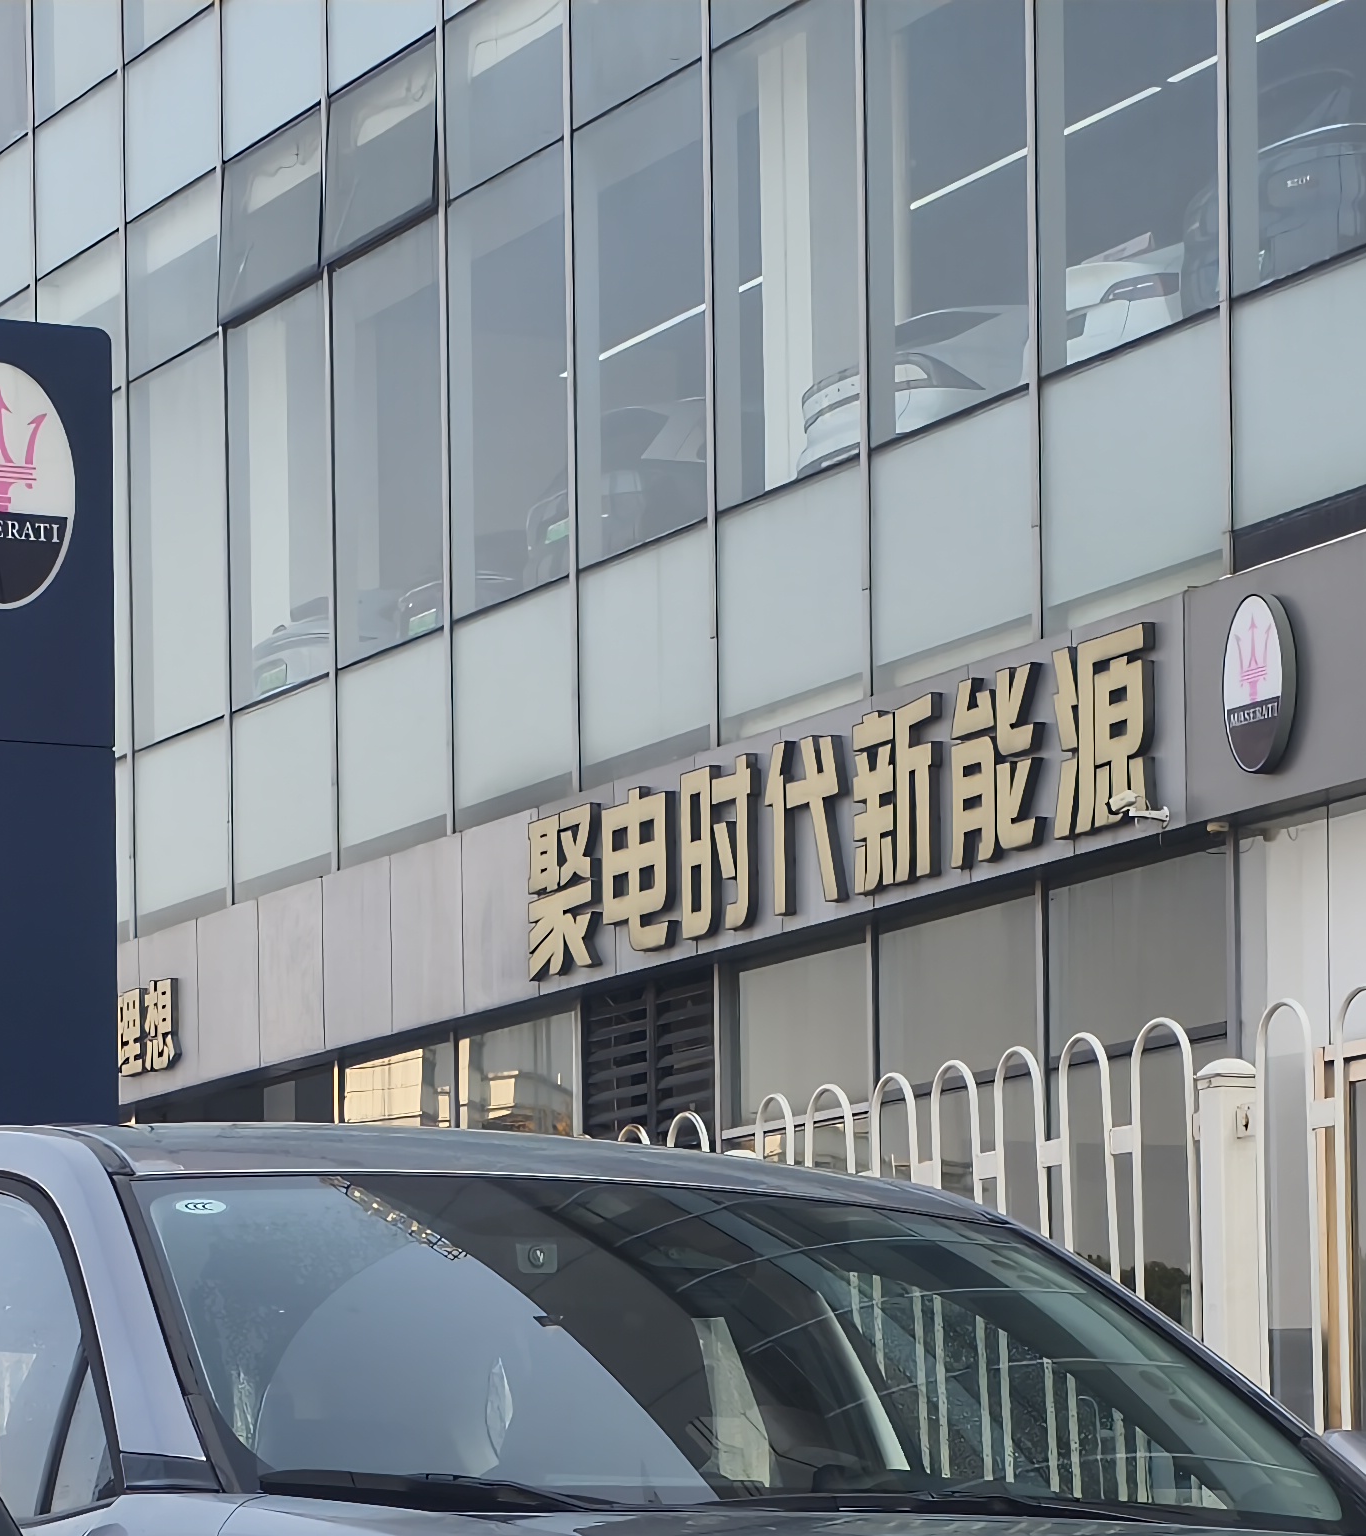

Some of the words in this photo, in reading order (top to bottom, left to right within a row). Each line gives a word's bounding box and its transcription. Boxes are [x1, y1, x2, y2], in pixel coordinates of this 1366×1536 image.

[527, 622, 1155, 981] 聚电时代新能源
[1230, 702, 1279, 727] MASERATI
